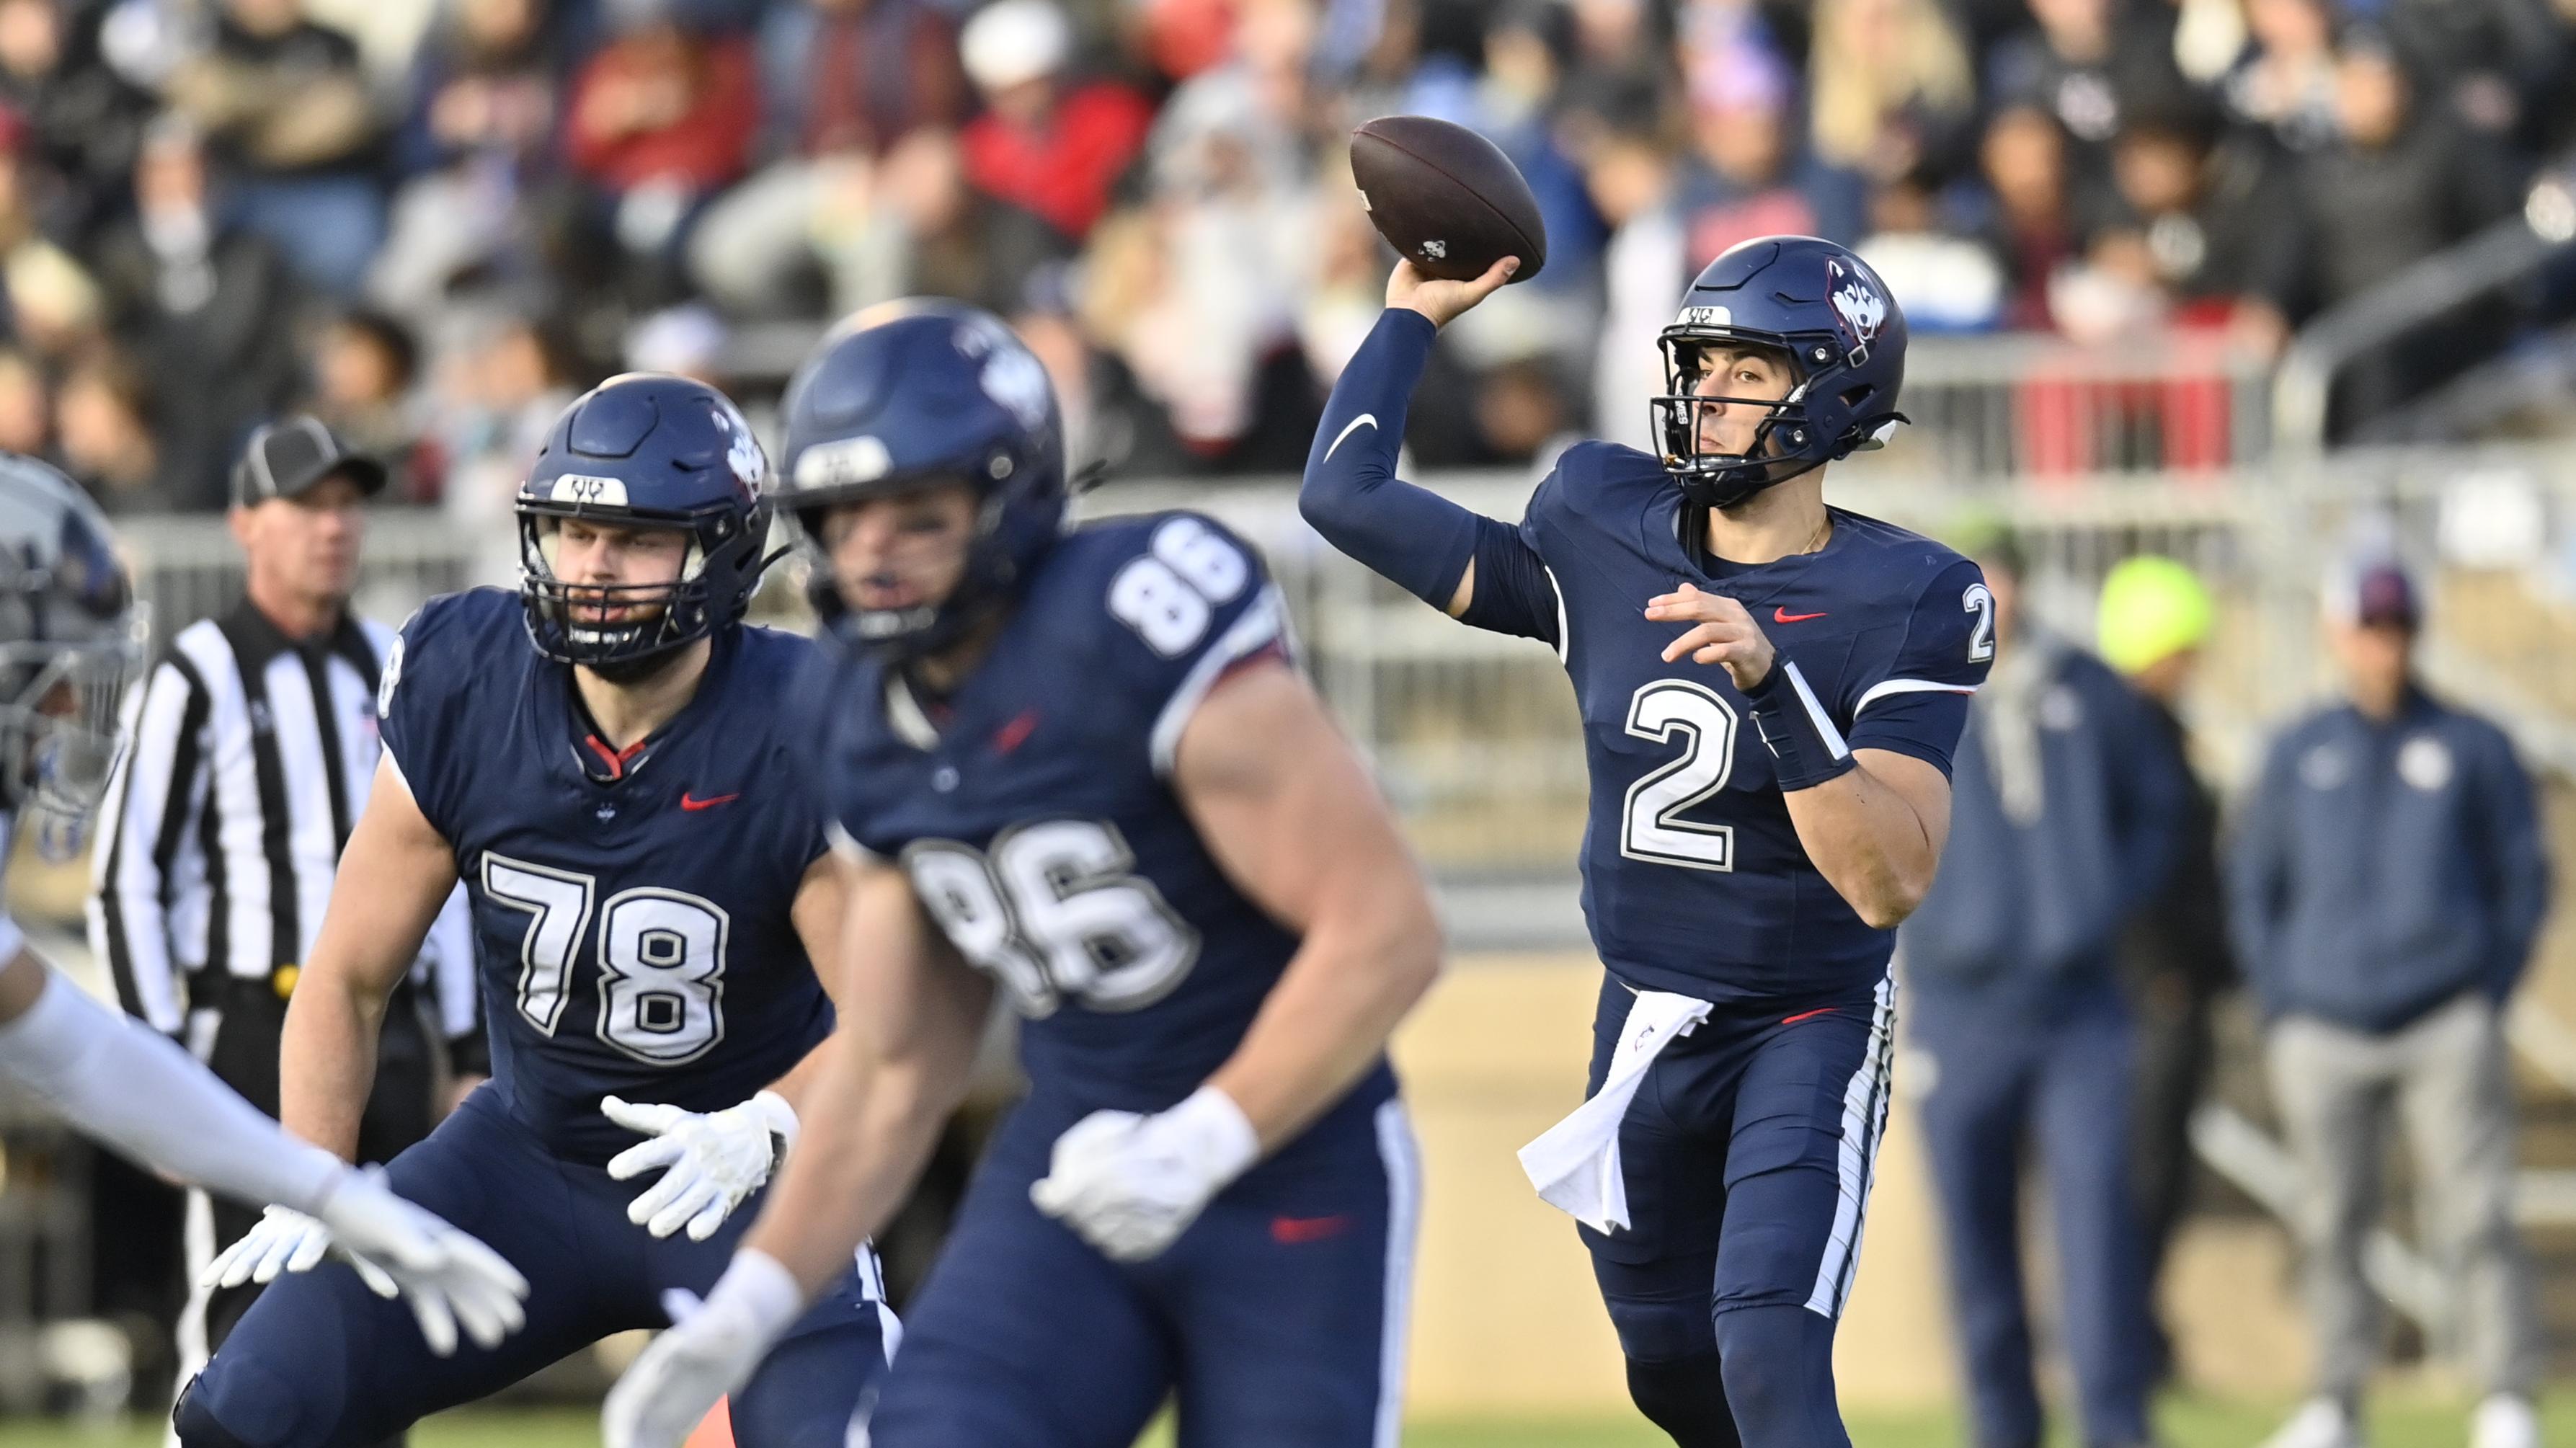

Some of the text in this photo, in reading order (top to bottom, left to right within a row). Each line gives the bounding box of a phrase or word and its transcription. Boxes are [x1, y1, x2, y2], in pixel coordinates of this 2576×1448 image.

[1106, 514, 1251, 659] 86
[1962, 583, 1996, 664] 2
[1620, 678, 1738, 873] 2
[481, 850, 729, 1067] 78
[899, 813, 1202, 1018] 86
